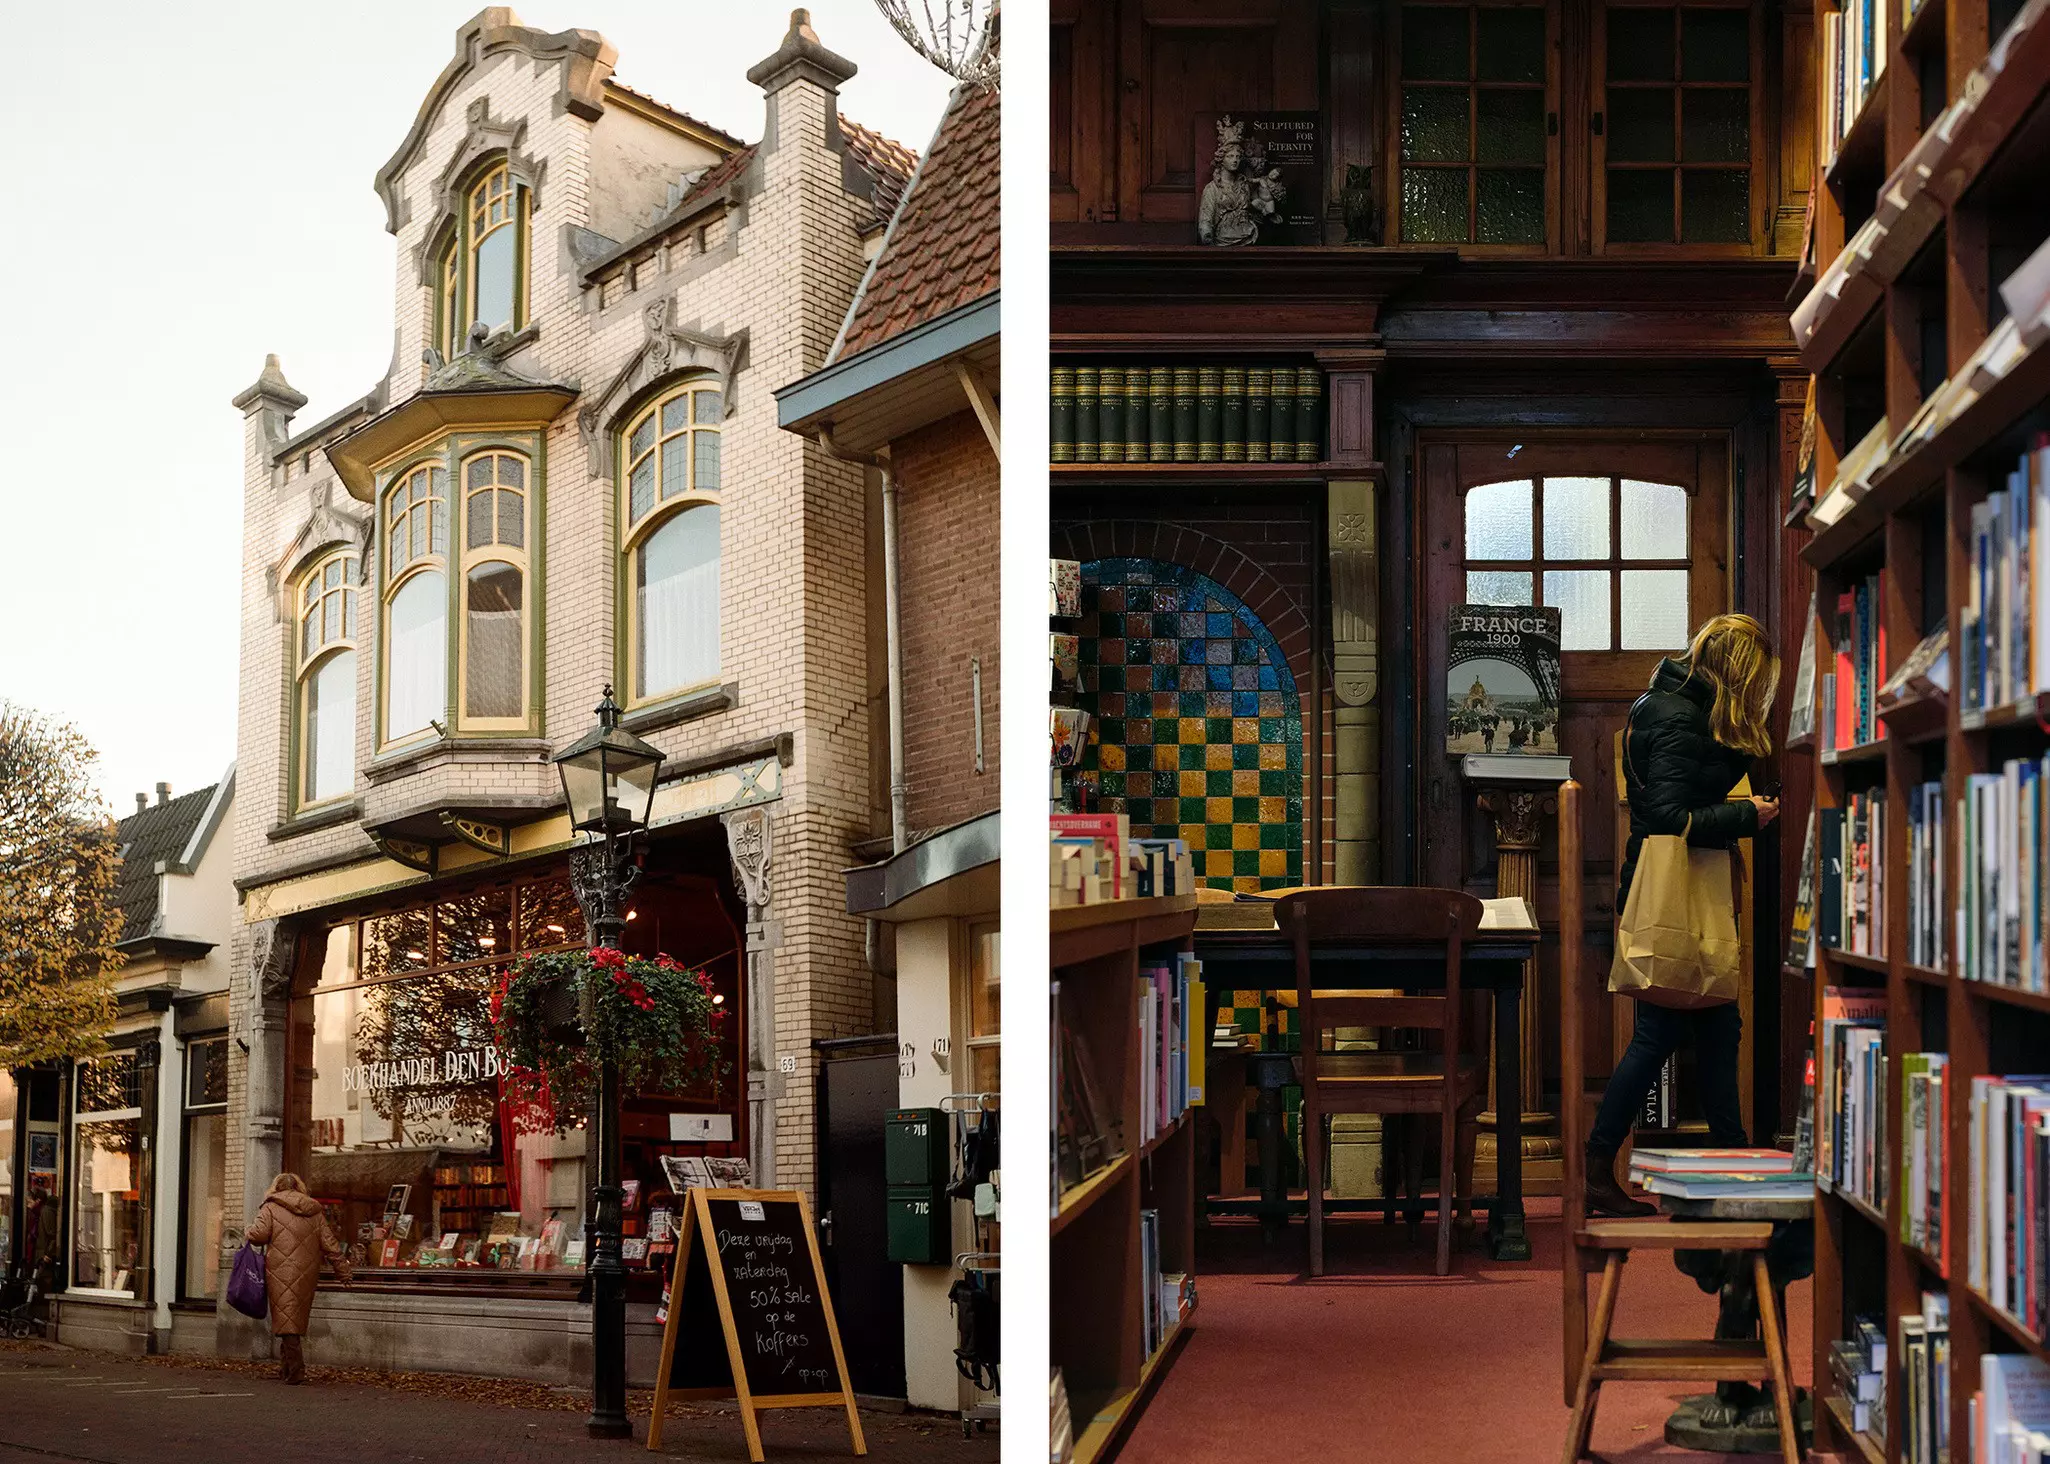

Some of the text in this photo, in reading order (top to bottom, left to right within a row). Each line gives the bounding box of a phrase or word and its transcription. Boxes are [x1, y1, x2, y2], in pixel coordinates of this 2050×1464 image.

[1253, 120, 1314, 130] SCULPTURED
[1296, 132, 1314, 140] FOR
[1268, 141, 1314, 151] ETERNITY
[1460, 616, 1547, 634] FRANCE
[1487, 633, 1521, 645] 1900
[342, 1045, 510, 1092] BOEKHANDEL DEN BO
[782, 1058, 793, 1071] 69
[431, 1094, 457, 1112] 1887
[1646, 1089, 1657, 1123] ATLAS
[913, 1123, 927, 1136] 71B
[914, 1202, 929, 1215] 71C
[718, 1229, 751, 1254] Deze
[745, 1250, 757, 1260] en
[750, 1286, 780, 1308] 50%
[765, 1311, 796, 1331] op de
